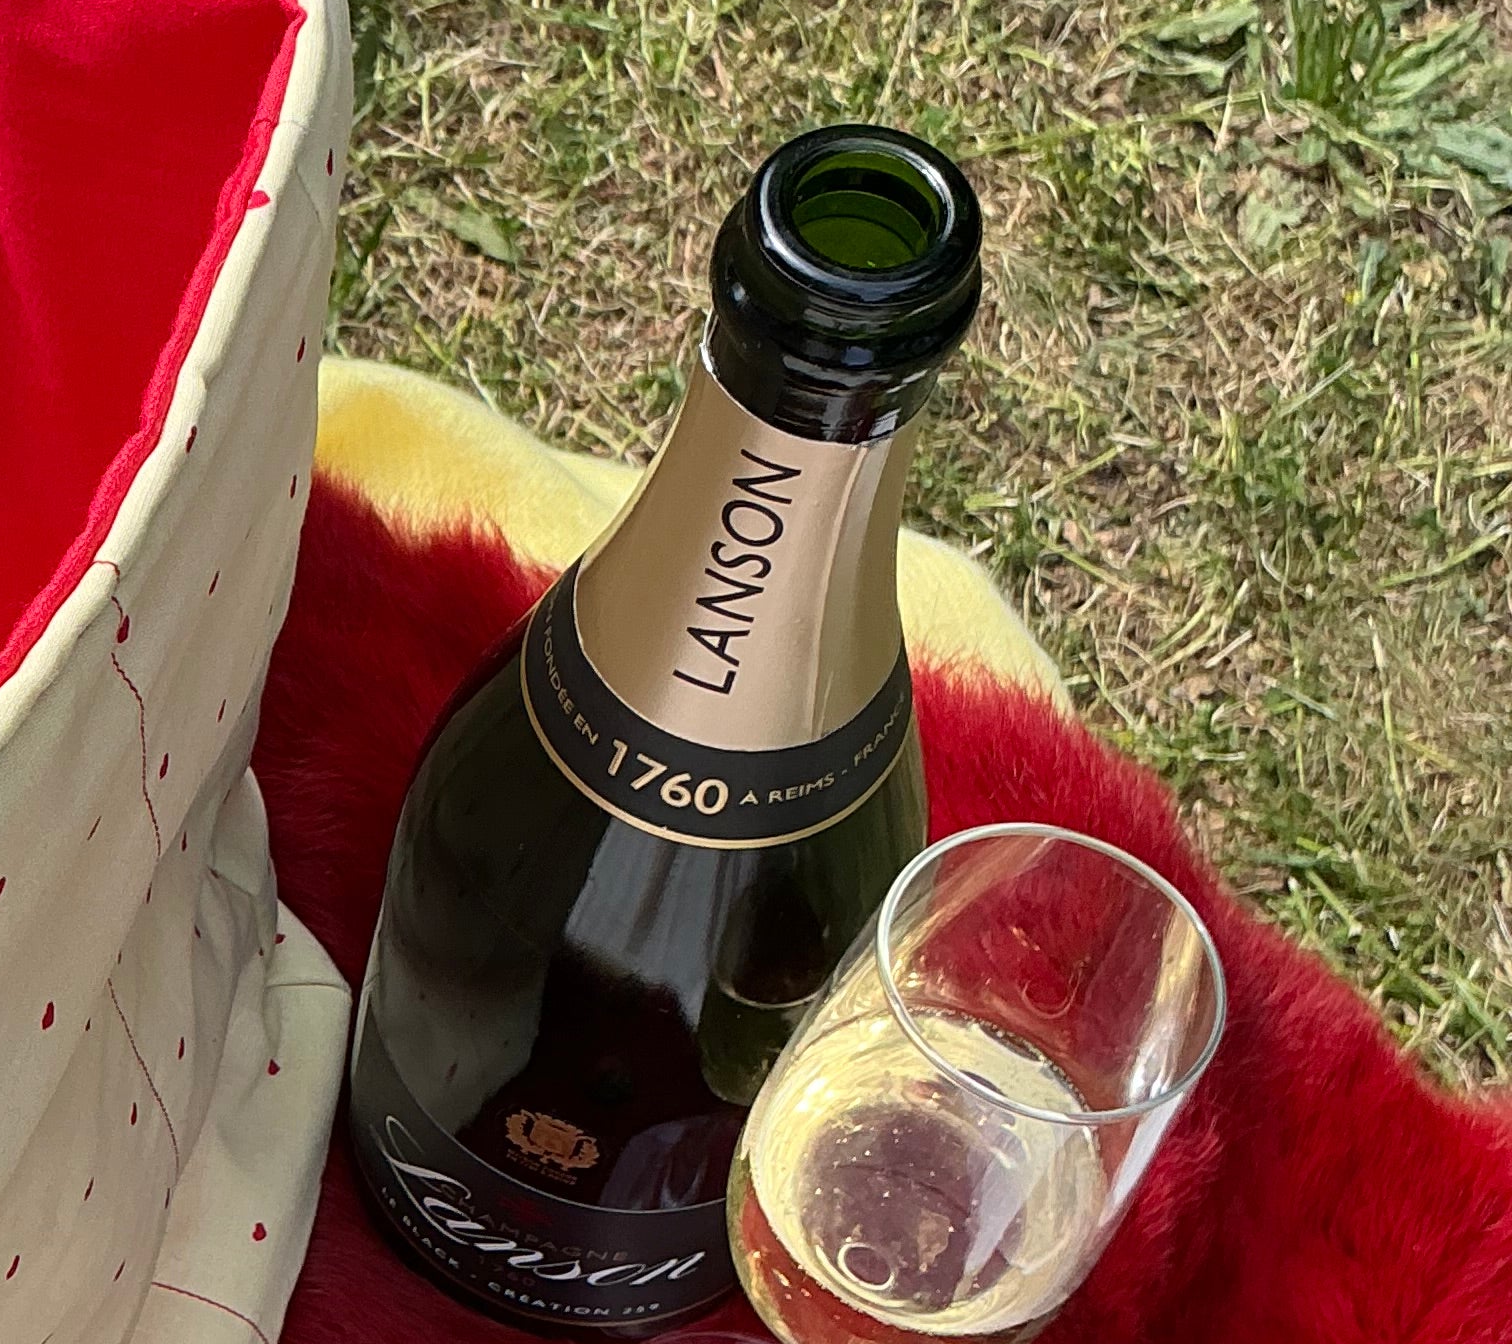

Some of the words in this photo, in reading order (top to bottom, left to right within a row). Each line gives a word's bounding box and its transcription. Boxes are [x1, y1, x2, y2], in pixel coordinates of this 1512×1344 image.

[672, 448, 802, 695] LANSON
[573, 712, 599, 745] EN
[607, 738, 729, 815] 1760
[768, 772, 835, 805] REIMS
[369, 1113, 707, 1287] Lanson
